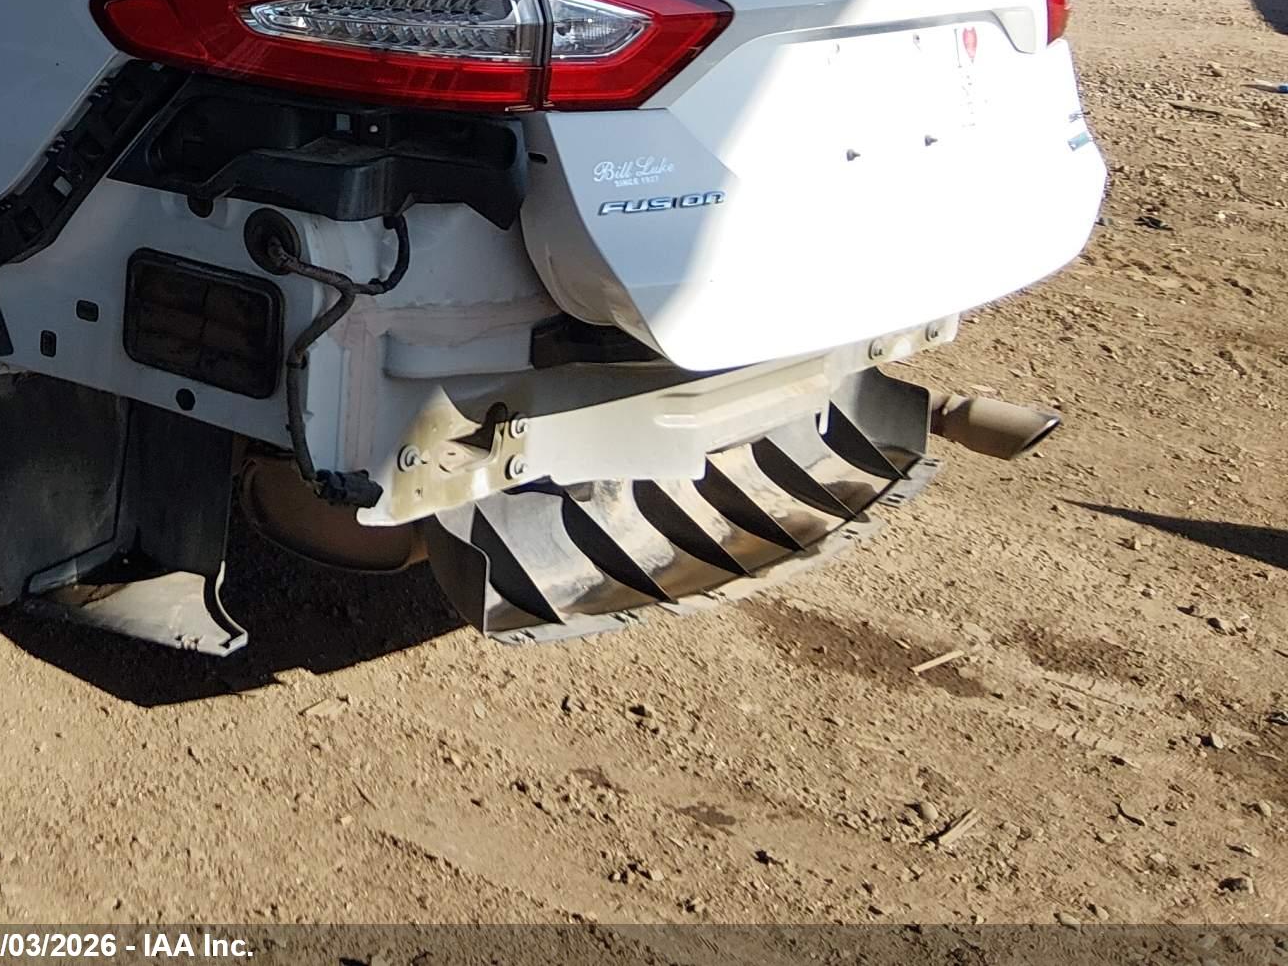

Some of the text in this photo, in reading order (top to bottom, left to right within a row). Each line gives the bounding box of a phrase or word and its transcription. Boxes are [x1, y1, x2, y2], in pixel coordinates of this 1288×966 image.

[593, 156, 676, 182] Bill Luke
[597, 190, 727, 216] FUSION
